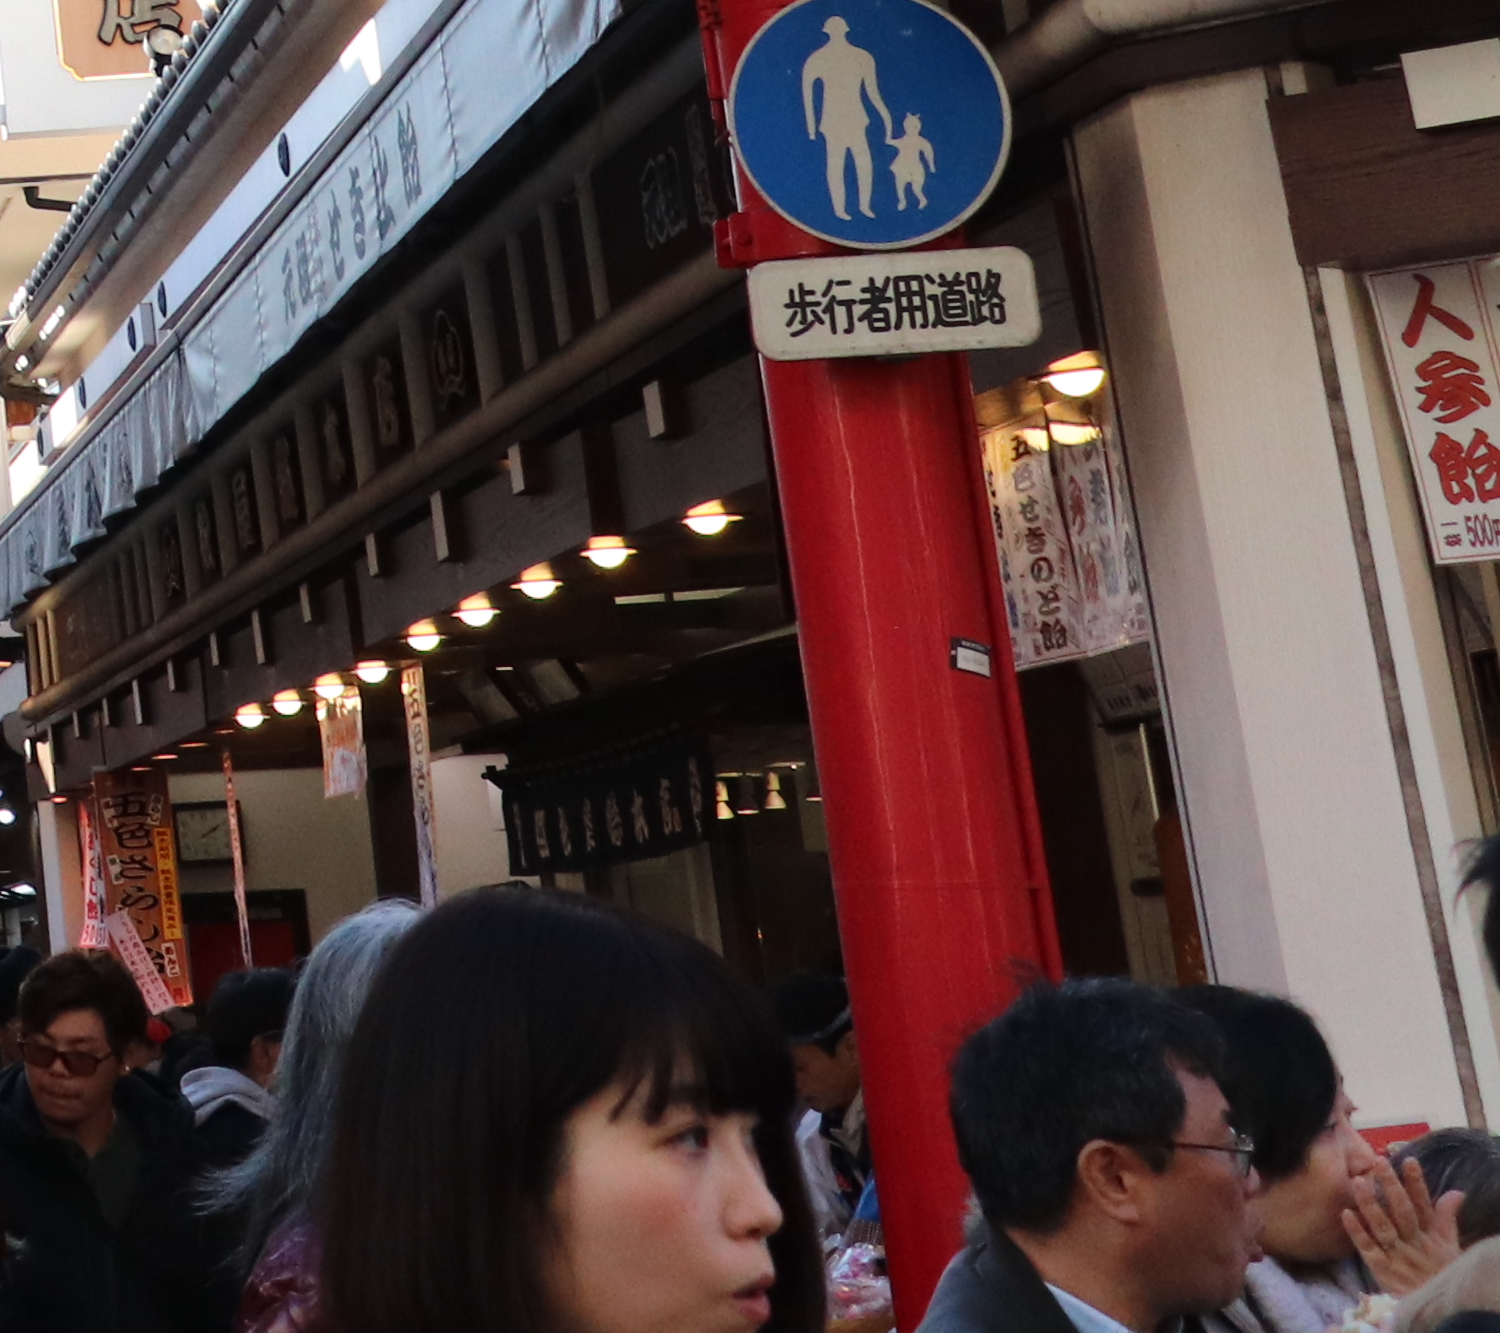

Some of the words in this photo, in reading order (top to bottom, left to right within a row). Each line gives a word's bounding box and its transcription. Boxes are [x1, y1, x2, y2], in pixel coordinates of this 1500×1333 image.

[783, 267, 1008, 339] 歩行者用道路
[1402, 273, 1500, 505] 人参飴
